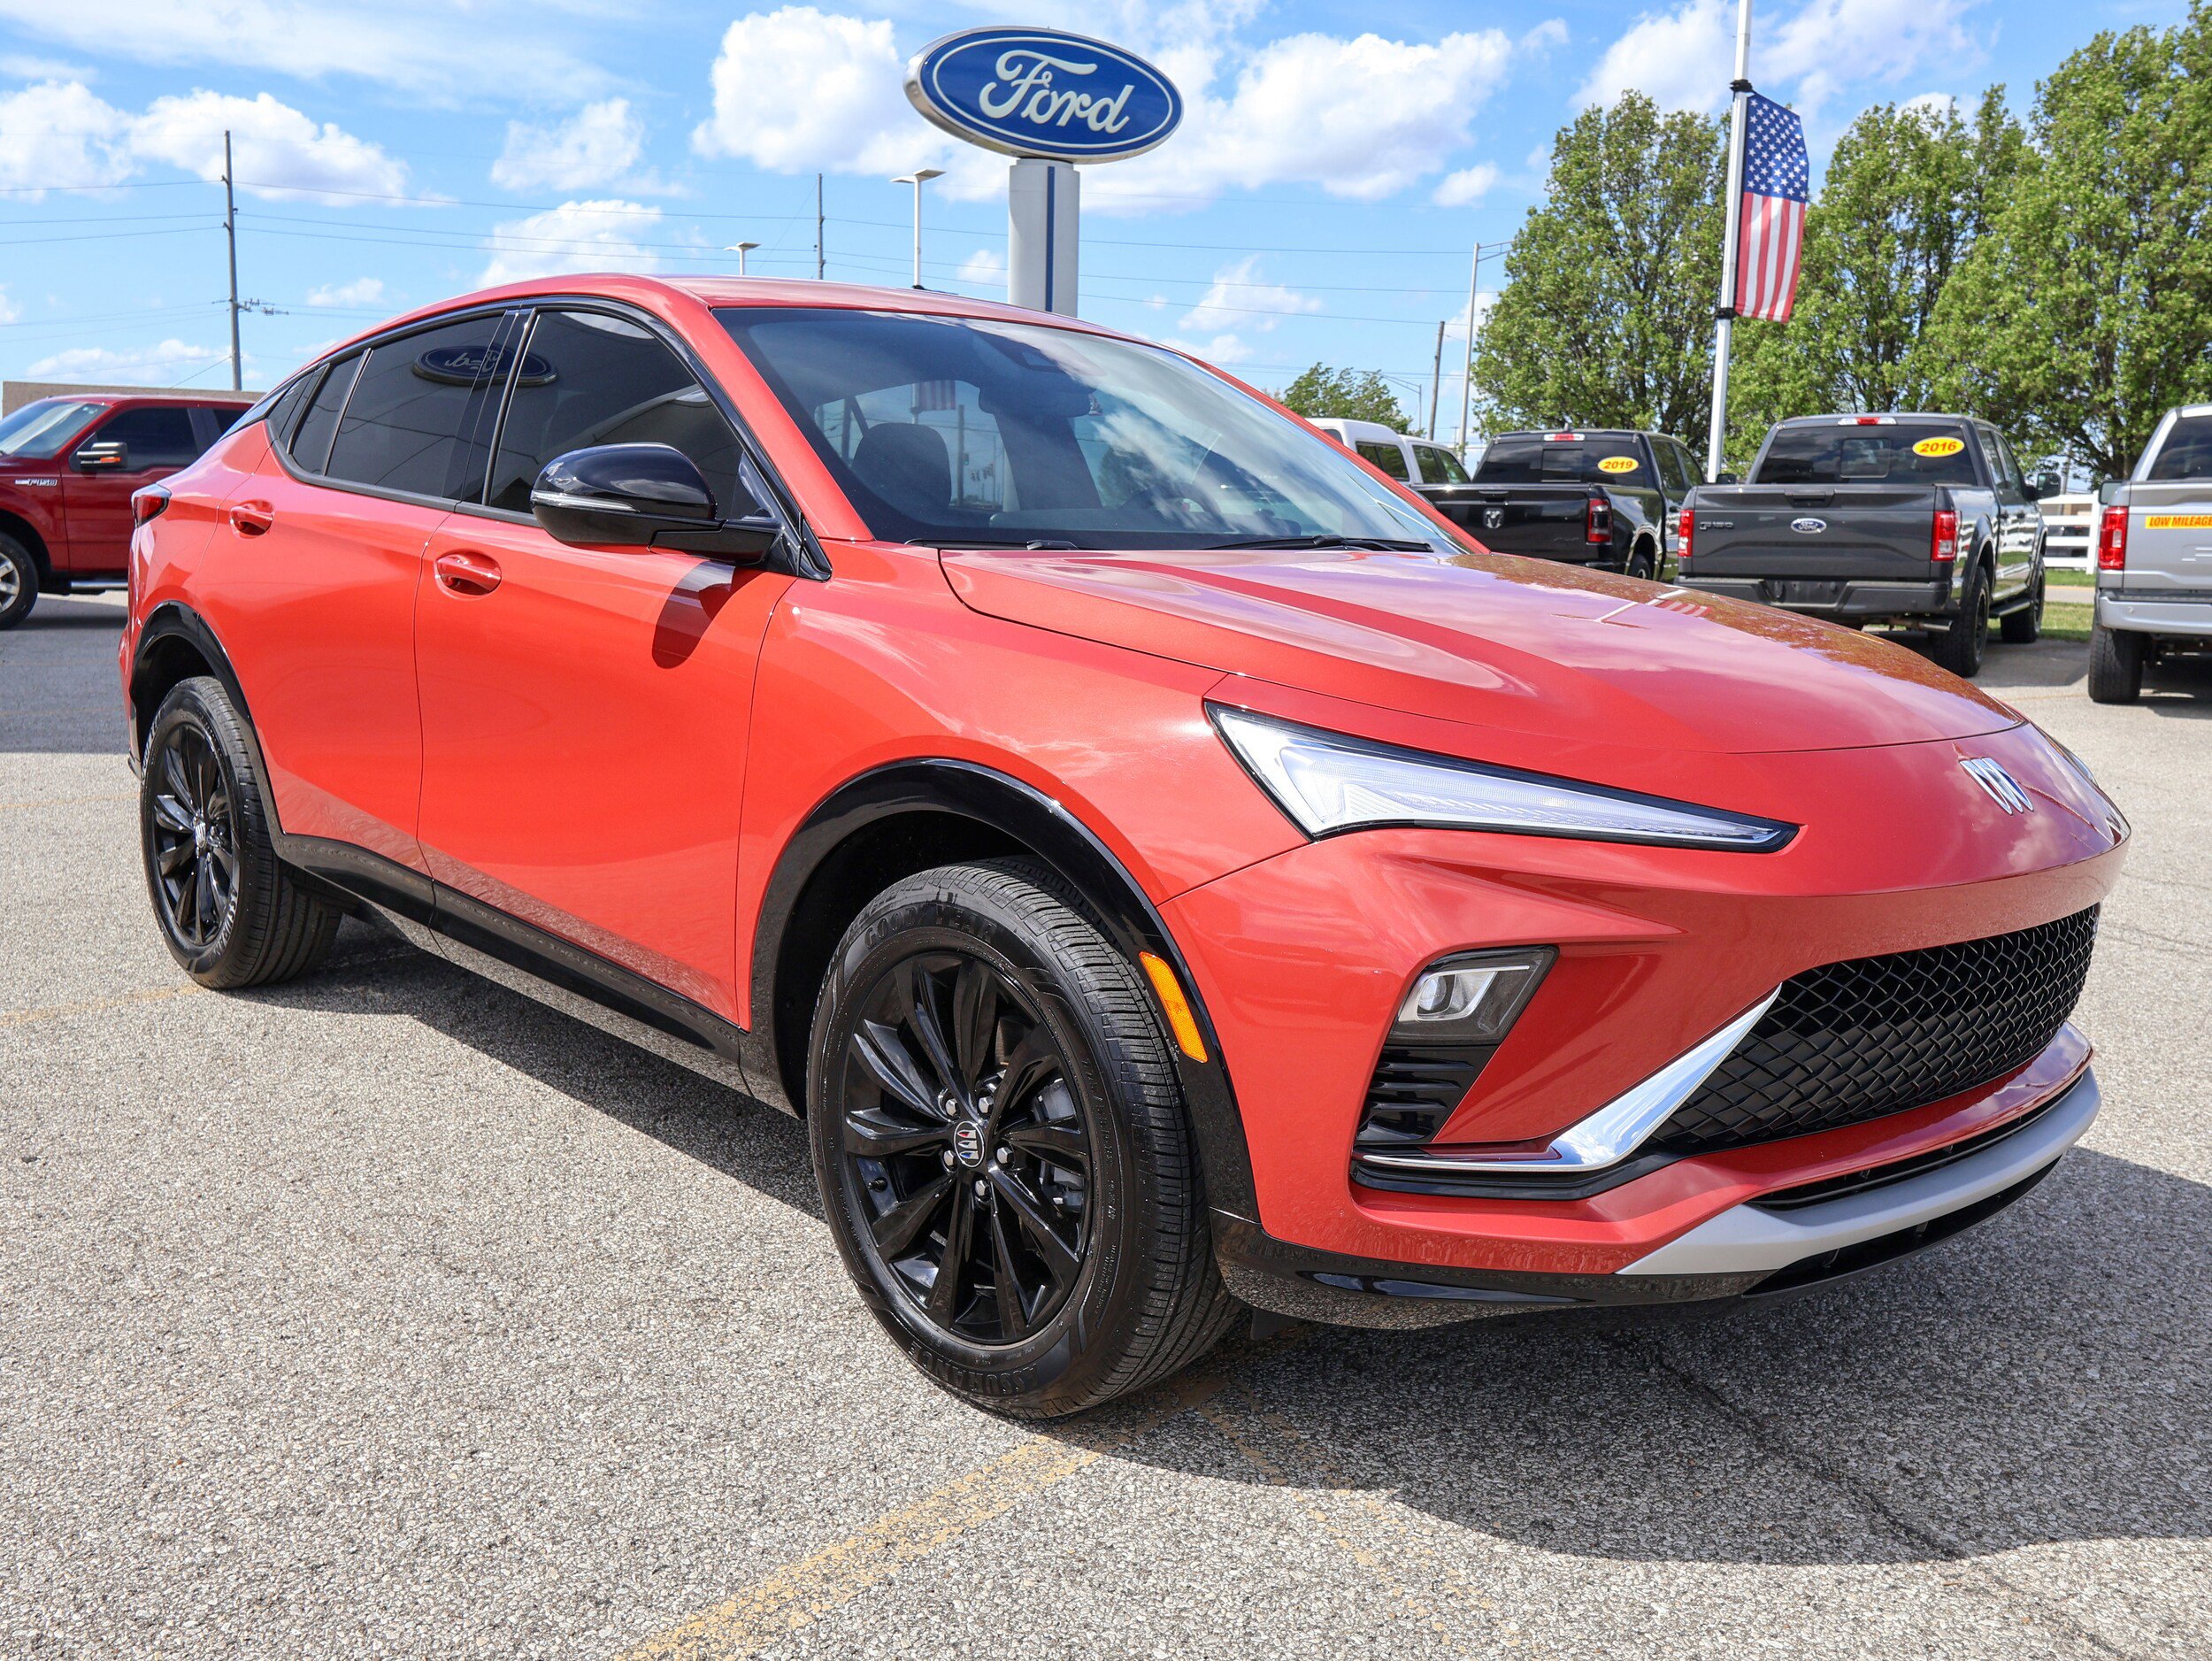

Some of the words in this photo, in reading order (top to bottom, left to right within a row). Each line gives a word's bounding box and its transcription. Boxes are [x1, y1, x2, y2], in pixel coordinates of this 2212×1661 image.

[979, 50, 1135, 134] Ford
[1920, 442, 1957, 453] 2016
[2149, 517, 2171, 527] LOW
[2171, 517, 2212, 527] MILEAGE
